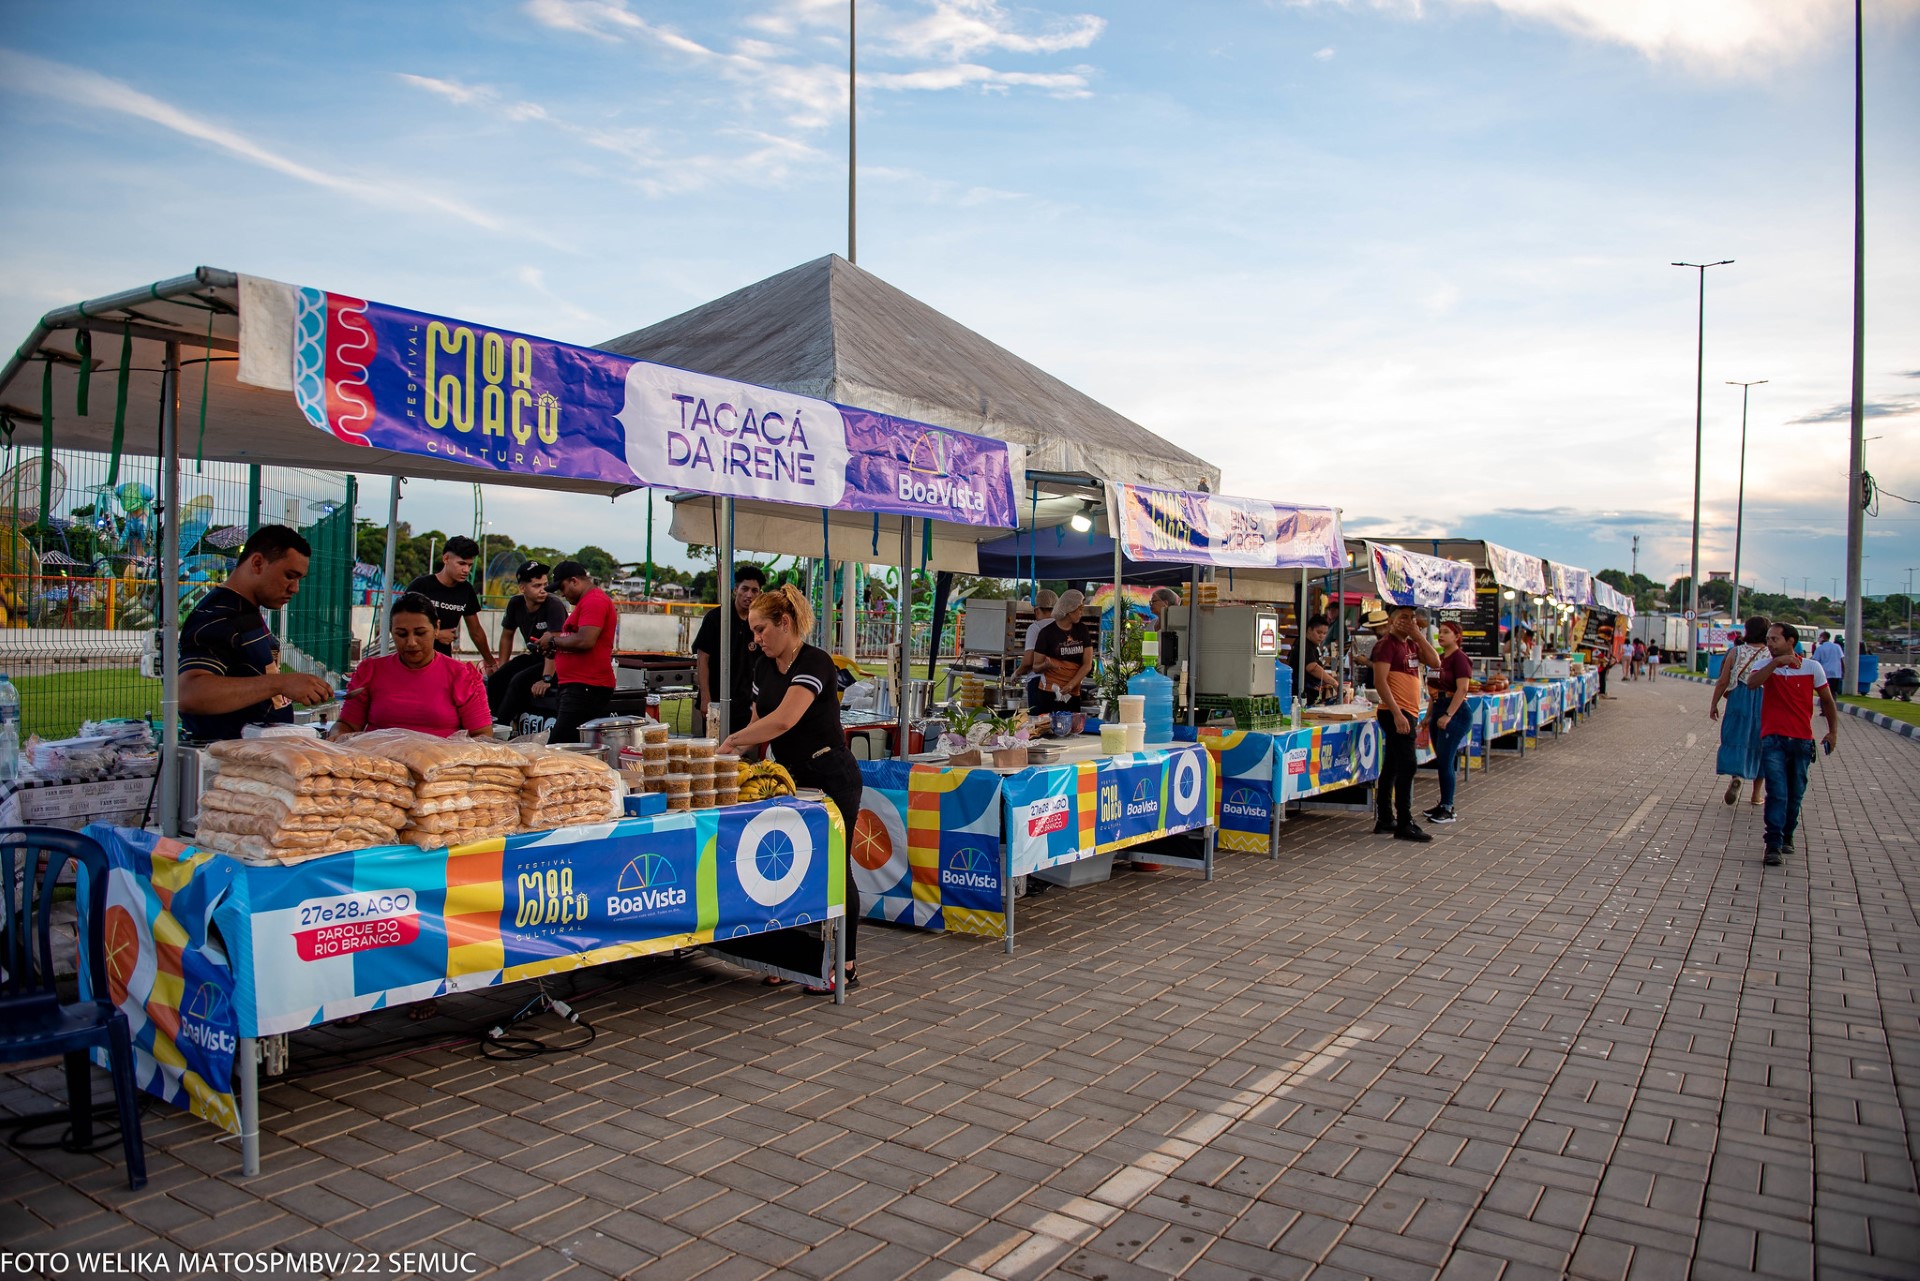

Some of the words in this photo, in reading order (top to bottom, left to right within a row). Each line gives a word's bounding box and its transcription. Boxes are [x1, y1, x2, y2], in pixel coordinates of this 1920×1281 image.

[406, 325, 418, 417] FESTIVAL
[671, 392, 809, 450] TACACÁ
[426, 441, 557, 468] CULTURAL
[667, 430, 715, 472] DA
[723, 440, 815, 486] IRENE
[1223, 803, 1267, 818] BoaVista
[517, 858, 573, 870] FESTIVAL
[942, 870, 997, 889] BoaVista
[300, 894, 410, 926] 27e28.AGO
[607, 887, 687, 917] BoaVista
[314, 941, 339, 956] RIO
[341, 932, 401, 951] BRANCO
[317, 923, 374, 943] PARQUE
[377, 920, 398, 932] DO
[515, 925, 583, 942] CULTURAL
